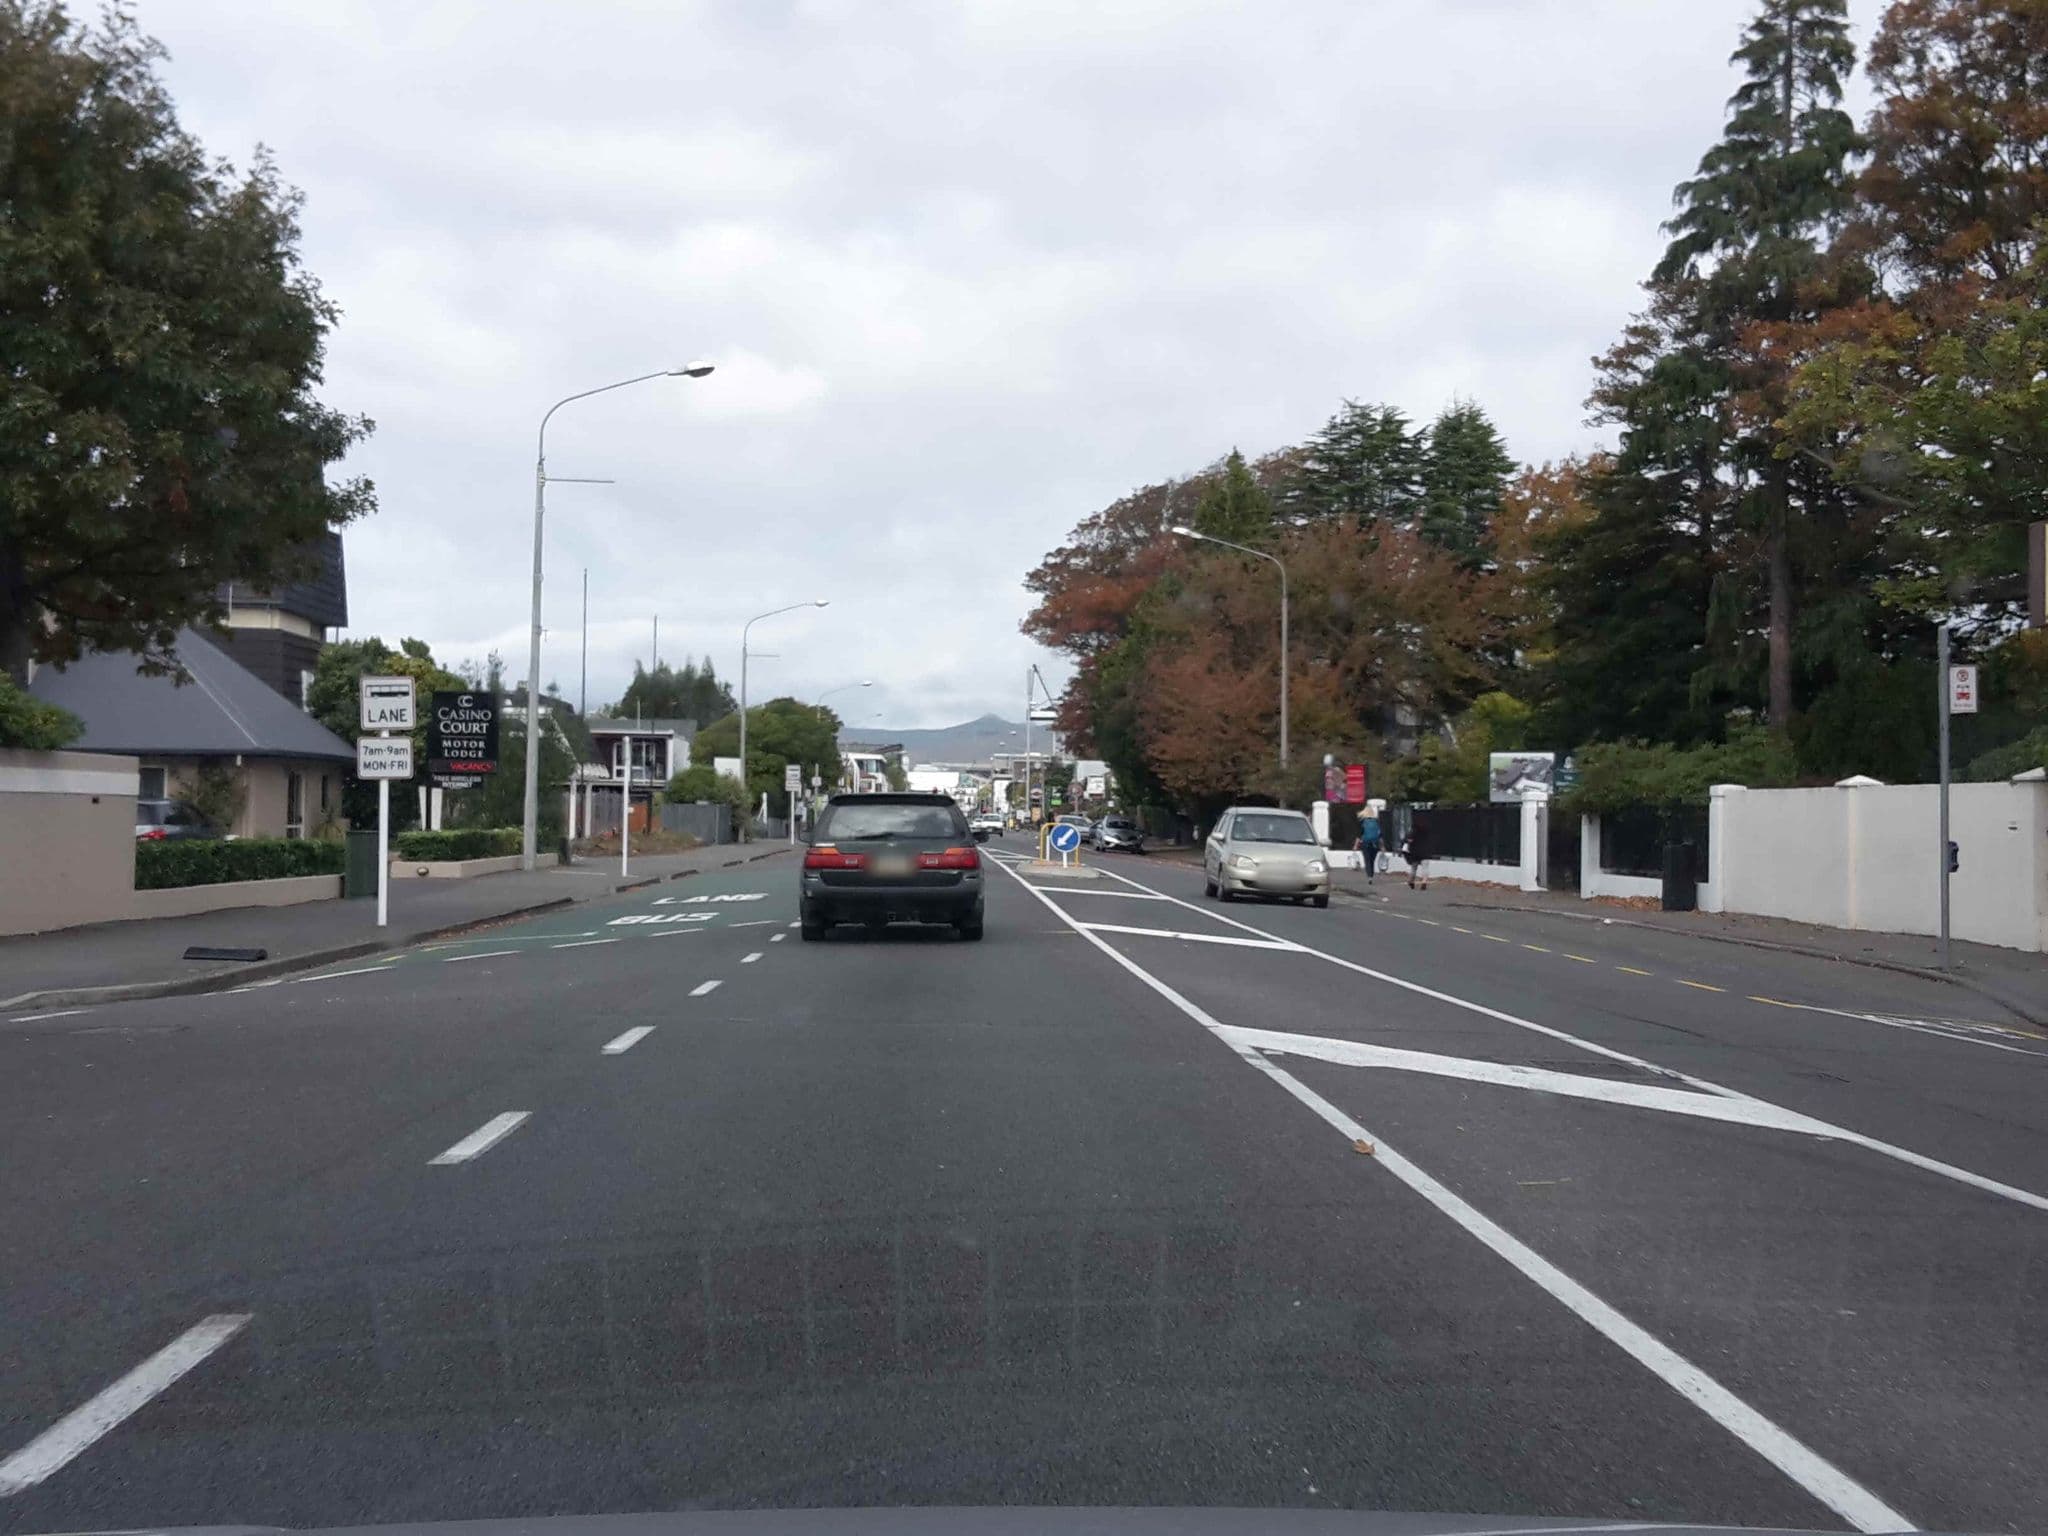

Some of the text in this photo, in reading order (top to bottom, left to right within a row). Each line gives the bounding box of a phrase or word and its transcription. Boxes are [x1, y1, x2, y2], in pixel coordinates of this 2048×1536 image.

[367, 708, 408, 723] LANE
[438, 707, 492, 721] CASINO
[440, 720, 489, 734] COURT
[442, 740, 486, 749] MOTOR
[444, 749, 484, 758] LODGE
[651, 892, 769, 905] LANE
[605, 912, 720, 926] BUS
